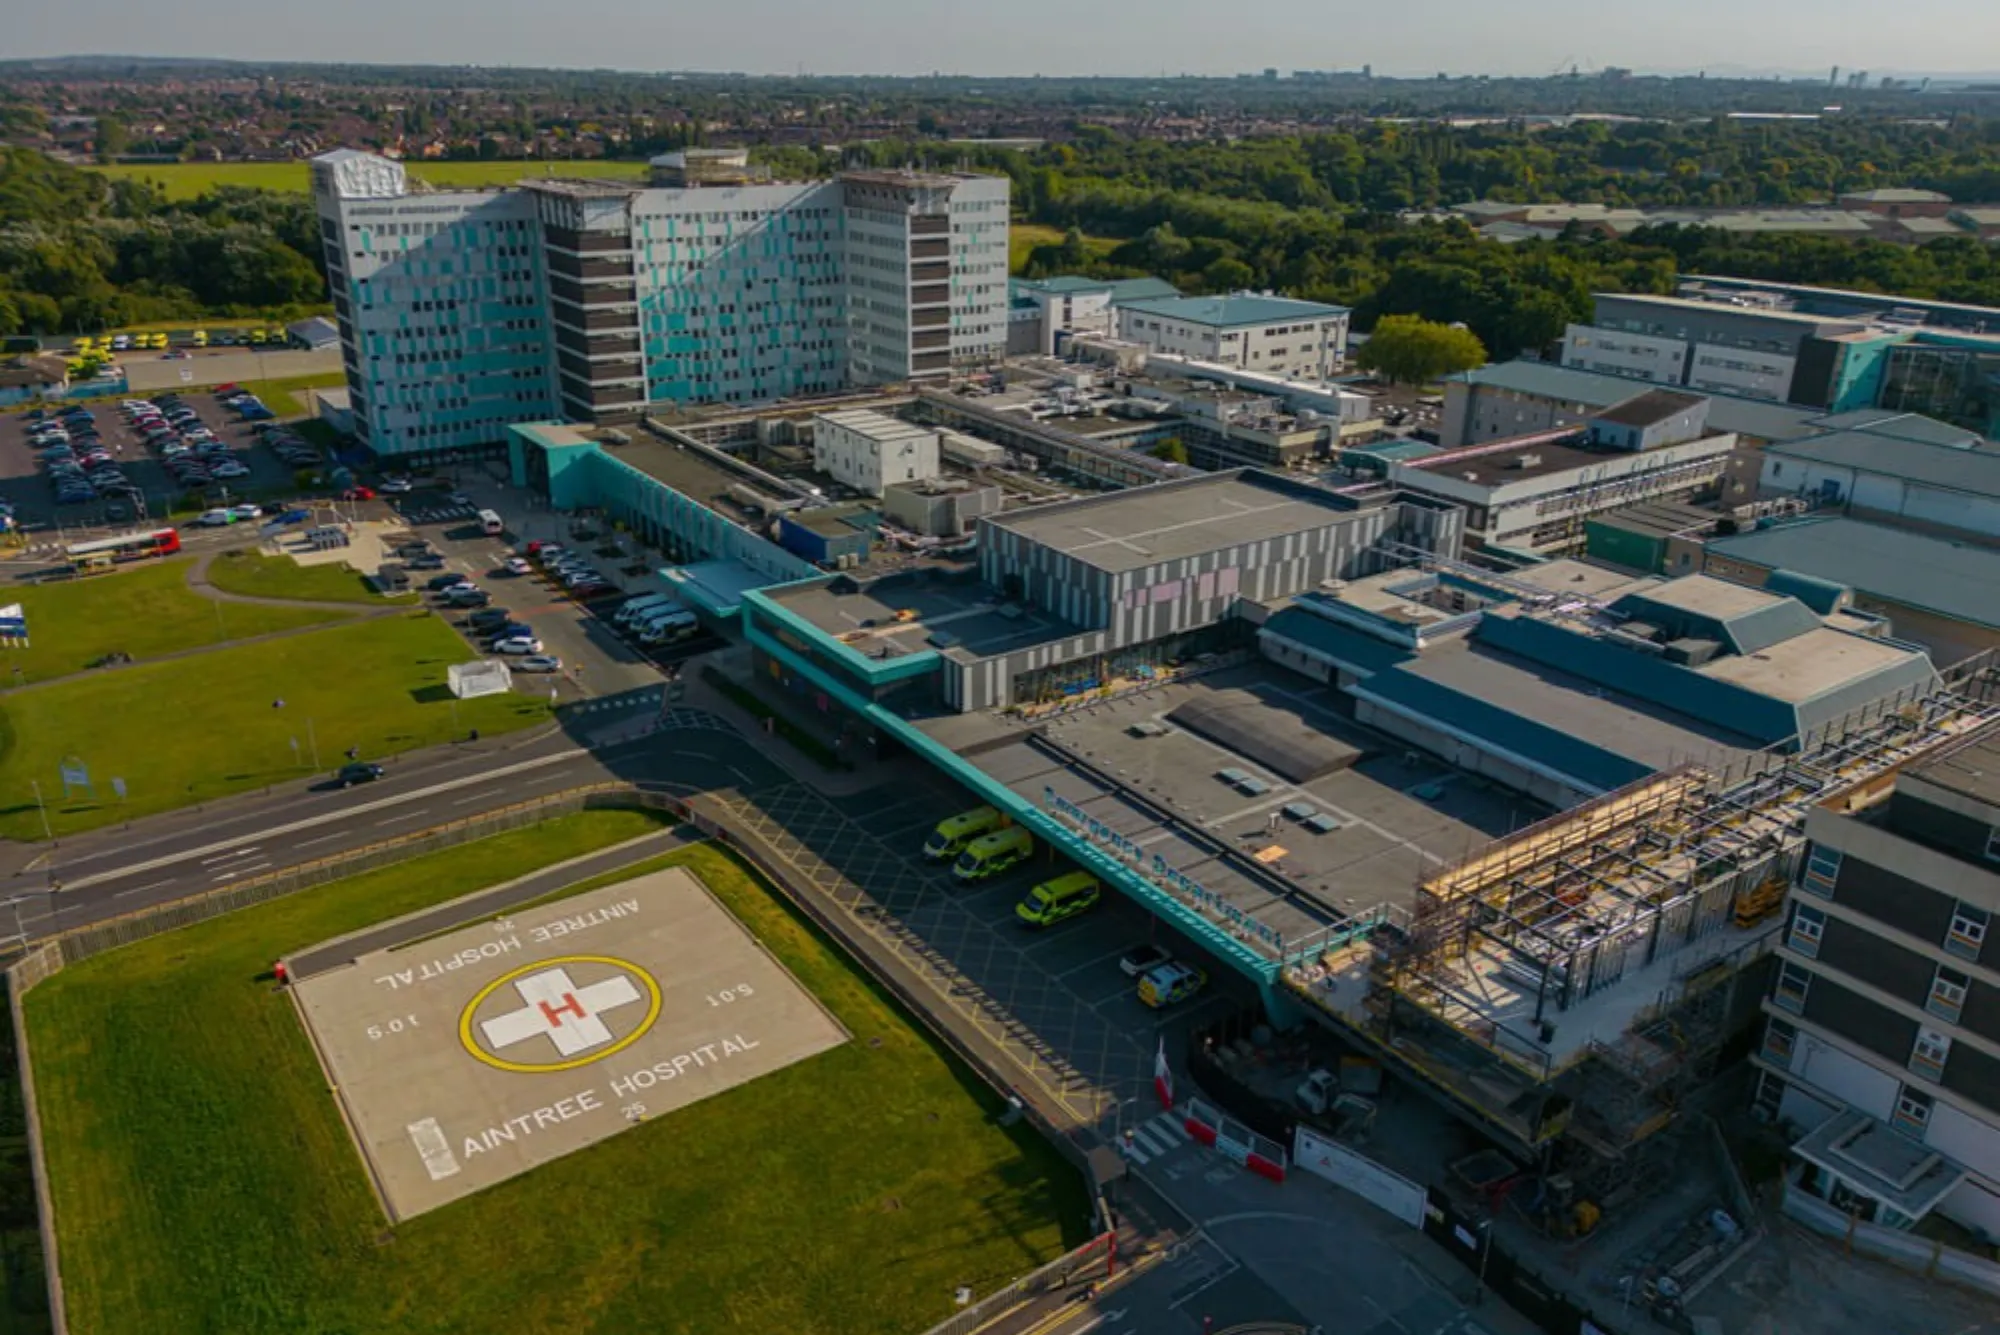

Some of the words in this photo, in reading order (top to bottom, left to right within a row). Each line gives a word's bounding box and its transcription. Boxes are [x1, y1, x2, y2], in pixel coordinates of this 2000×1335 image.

[531, 898, 640, 942] AINTREE
[373, 935, 522, 989] HOSPITAL
[537, 992, 586, 1027] H
[463, 1089, 604, 1158] AINTREE
[610, 1033, 760, 1098] HOSPITAL
